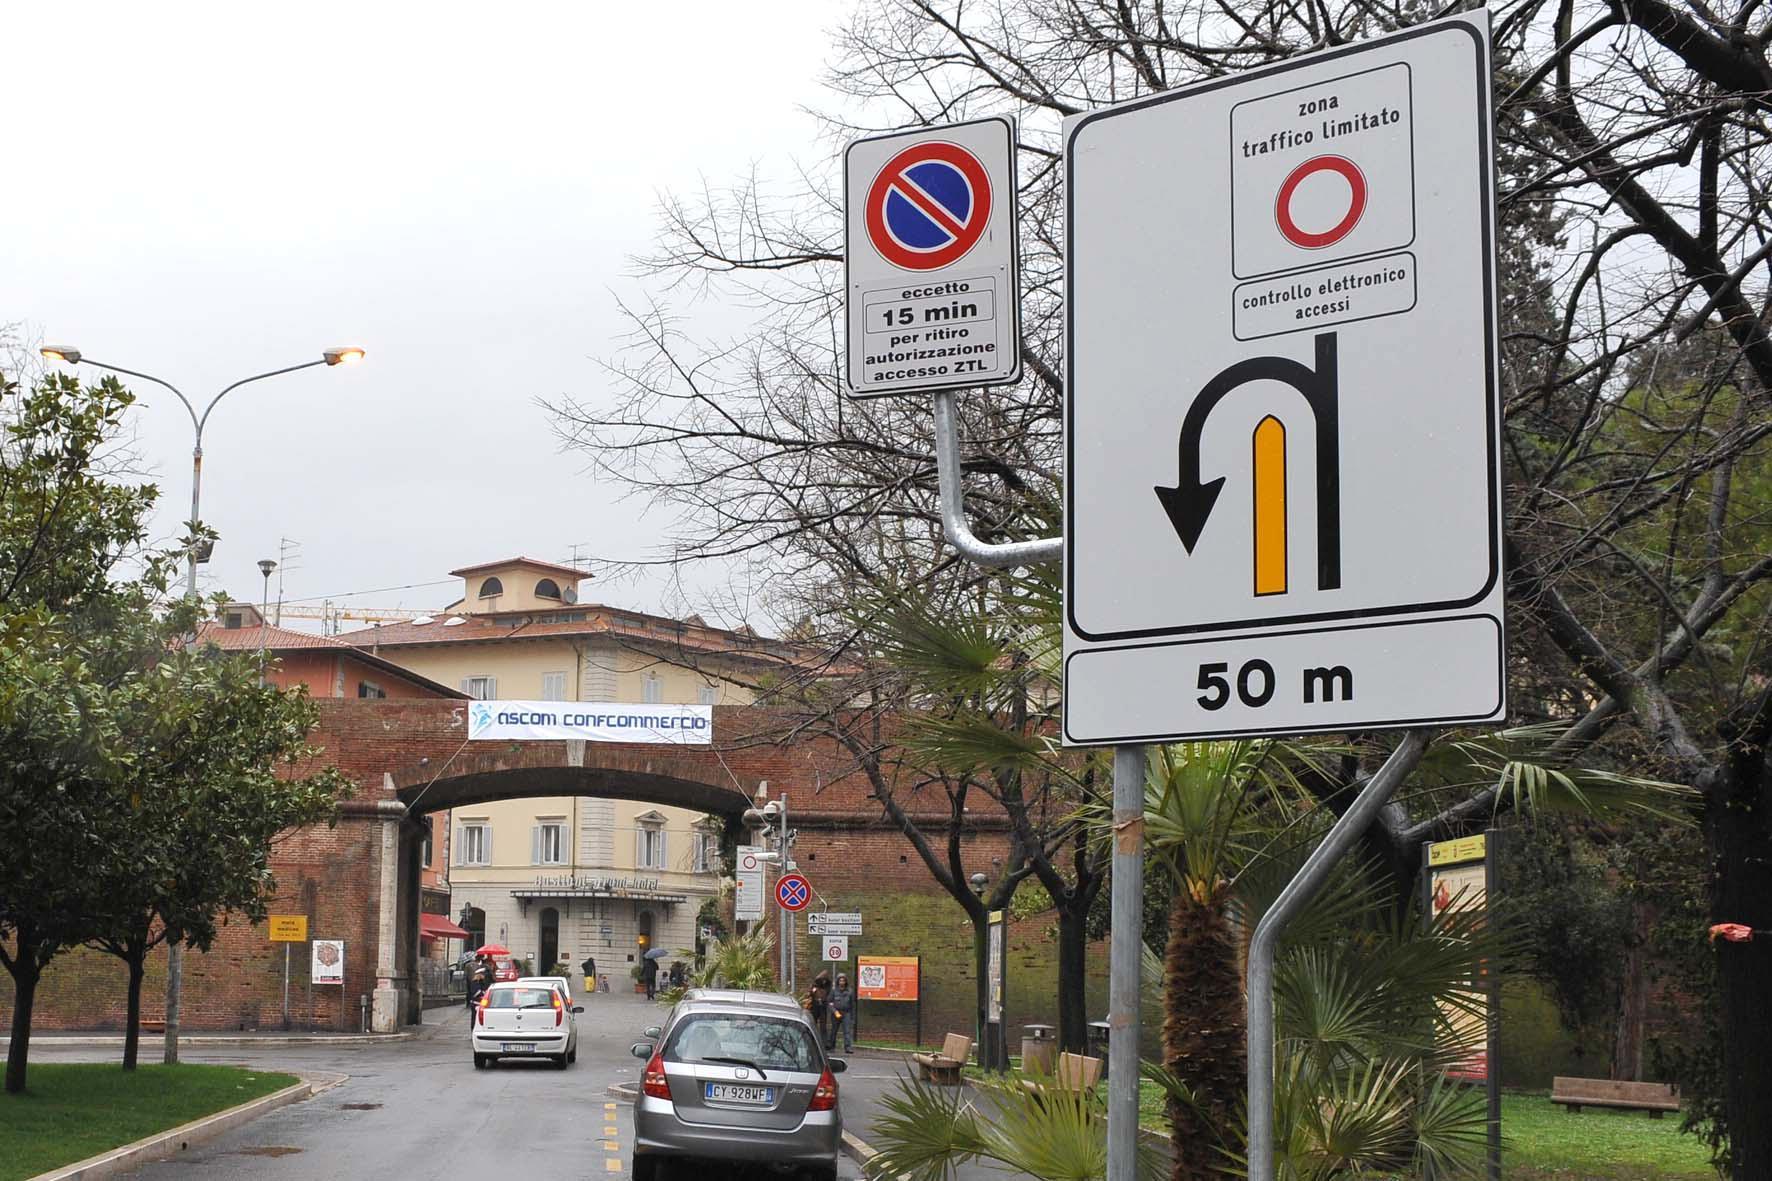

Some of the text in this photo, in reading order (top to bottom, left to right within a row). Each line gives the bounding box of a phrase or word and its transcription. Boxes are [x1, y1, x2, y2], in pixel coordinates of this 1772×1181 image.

[1298, 96, 1339, 117] zona
[1242, 107, 1400, 158] traffico limitato
[902, 282, 970, 299] eccetto
[1243, 268, 1406, 309] controllo elettronico
[882, 301, 977, 327] 15 min
[1295, 296, 1350, 319] accessi
[890, 328, 969, 348] per ritiro
[865, 343, 995, 365] autorizzazione
[874, 359, 988, 381] accesso ZTL
[1196, 658, 1353, 711] 50 m
